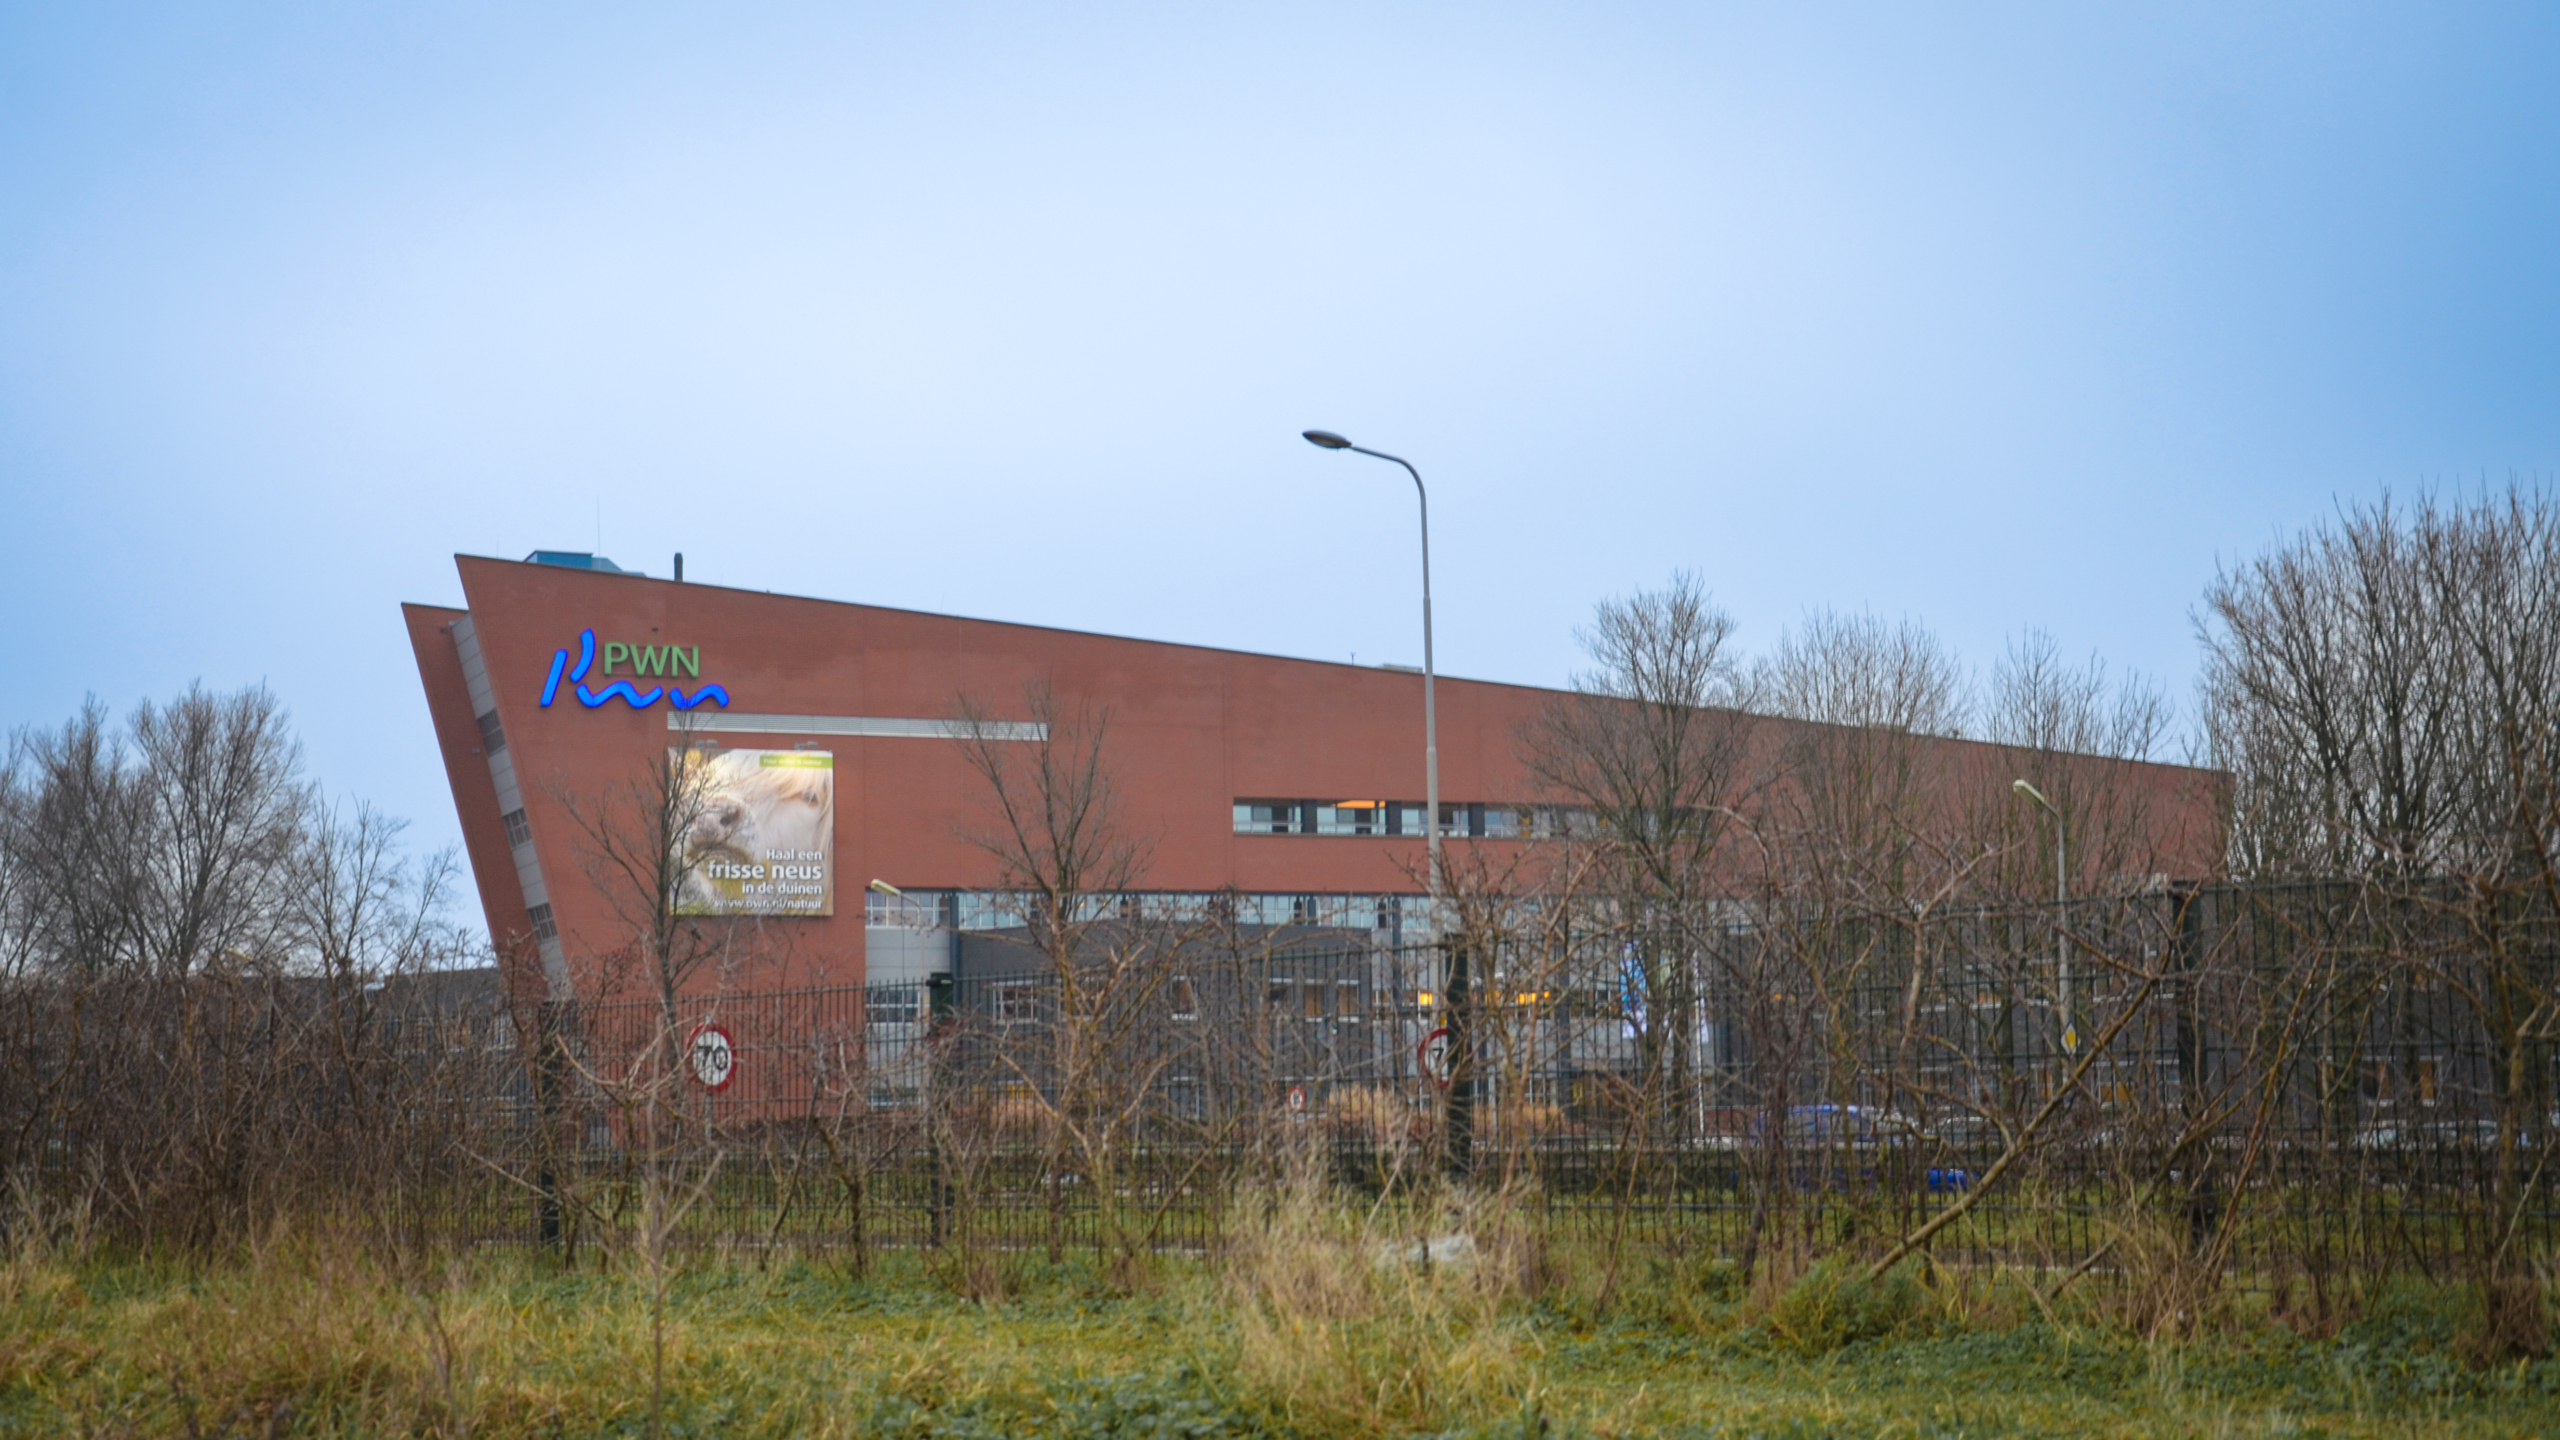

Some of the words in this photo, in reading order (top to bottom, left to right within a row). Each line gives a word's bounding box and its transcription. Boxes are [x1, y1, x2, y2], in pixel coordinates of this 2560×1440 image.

[604, 642, 699, 678] PWN
[766, 848, 794, 860] Haal
[798, 850, 822, 861] een
[708, 860, 765, 879] frisse
[771, 864, 822, 880] neus
[742, 882, 754, 894] in
[758, 882, 774, 894] de
[778, 882, 822, 894] duinen
[697, 1045, 728, 1071] 70
